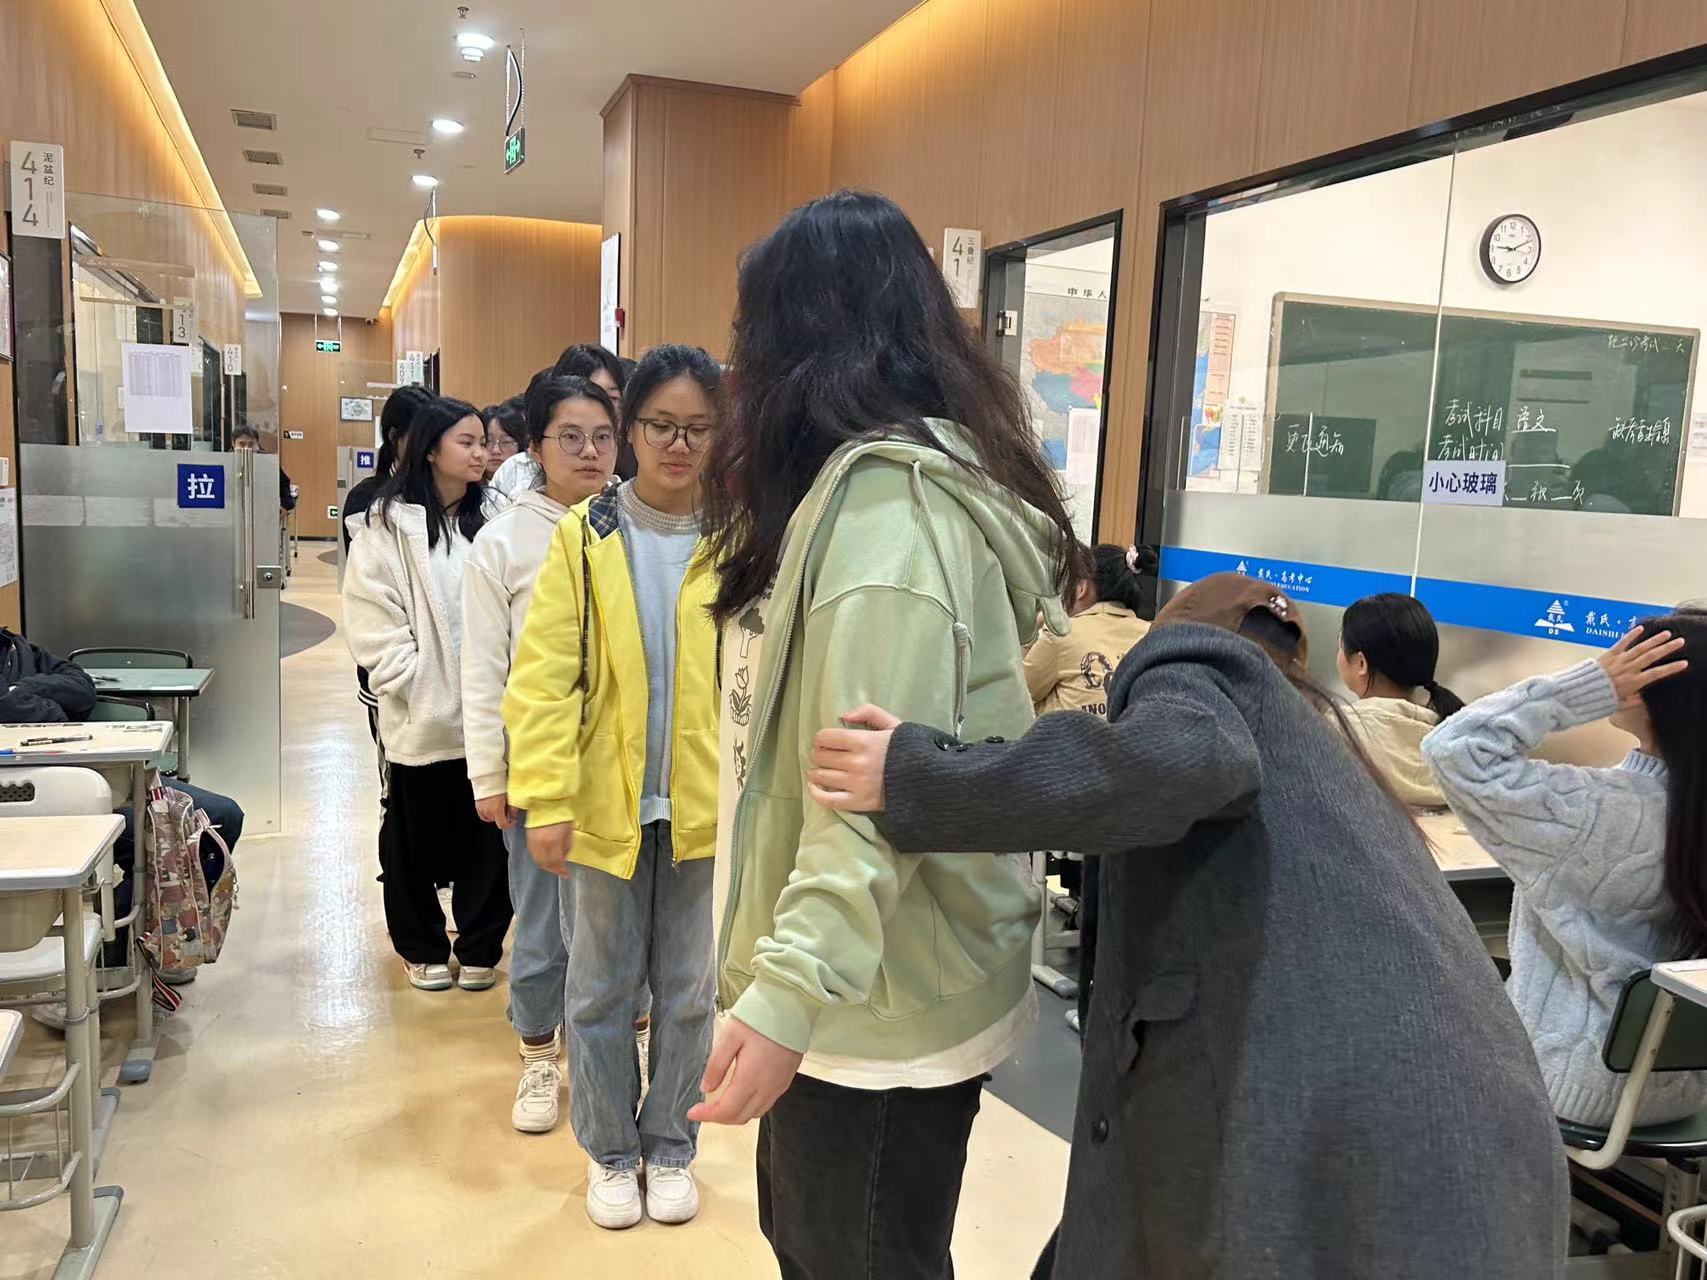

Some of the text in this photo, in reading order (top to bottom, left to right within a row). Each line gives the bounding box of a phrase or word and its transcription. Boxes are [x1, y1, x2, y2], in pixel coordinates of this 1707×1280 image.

[42, 152, 54, 186] 泥盆纪
[21, 151, 38, 226] 414
[952, 236, 963, 281] 41
[1445, 398, 1503, 438] 考试科目
[187, 473, 215, 499] 拉
[1429, 471, 1498, 495] 小心玻璃
